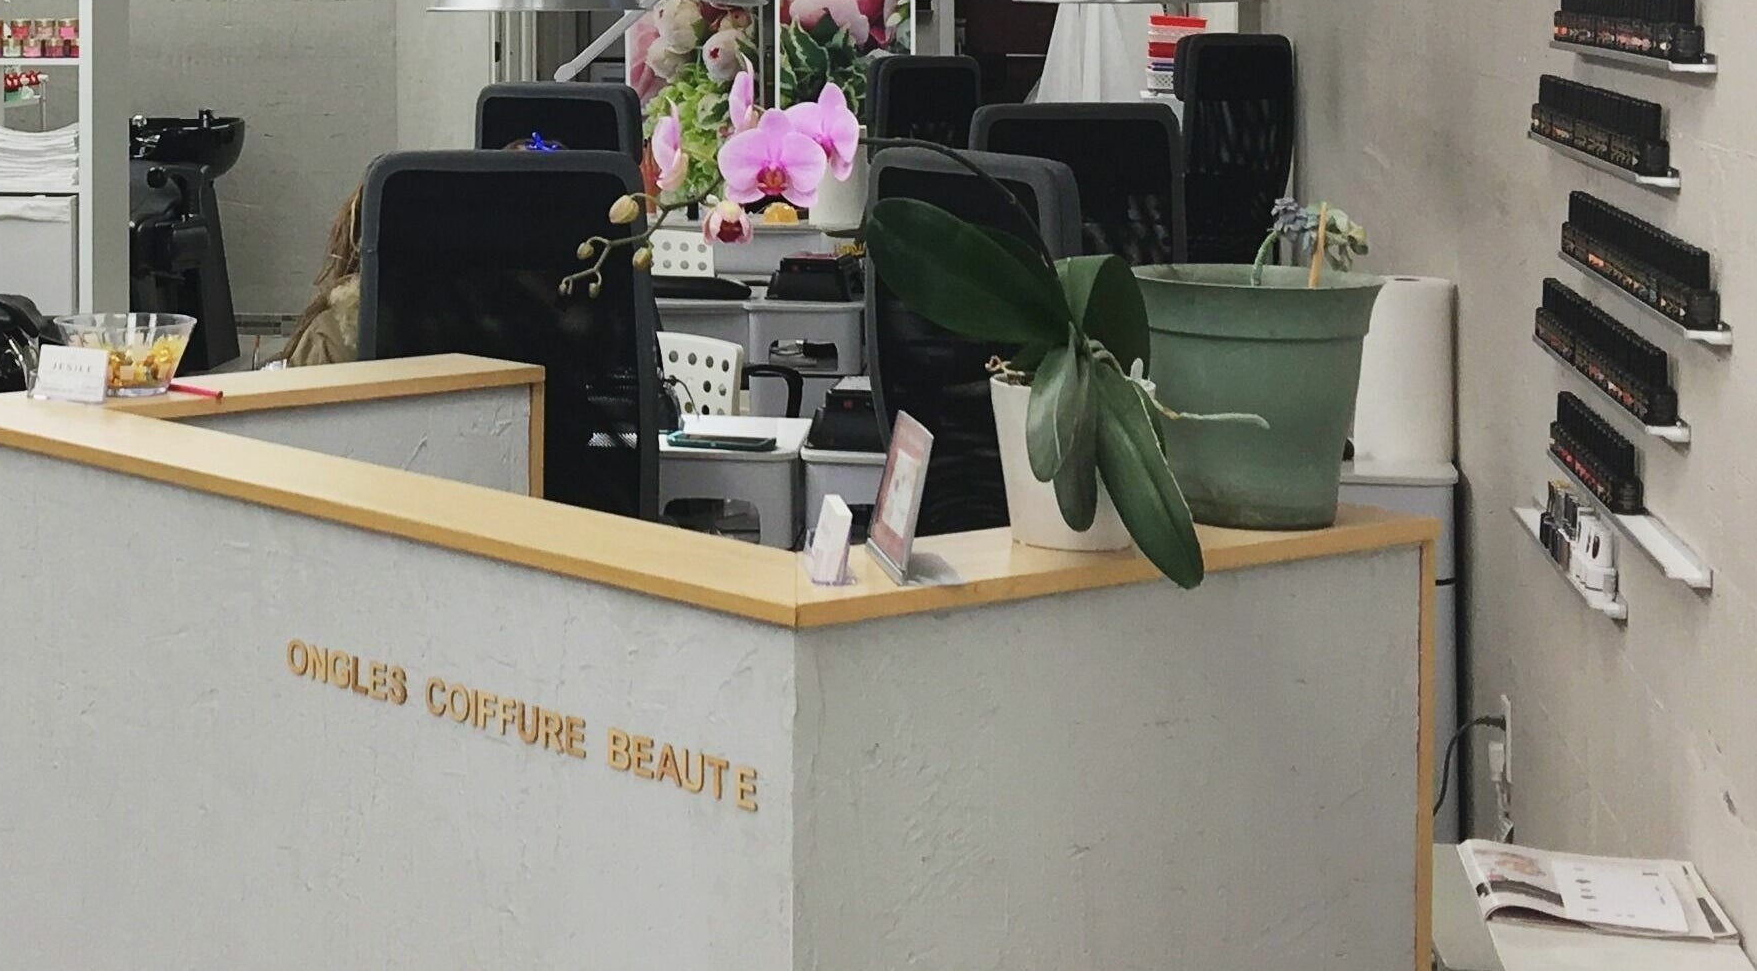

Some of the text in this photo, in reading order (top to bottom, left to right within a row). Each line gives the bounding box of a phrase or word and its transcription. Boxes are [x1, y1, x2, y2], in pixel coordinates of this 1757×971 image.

[286, 638, 759, 813] ONGLES COIFFURE BEAUTE
